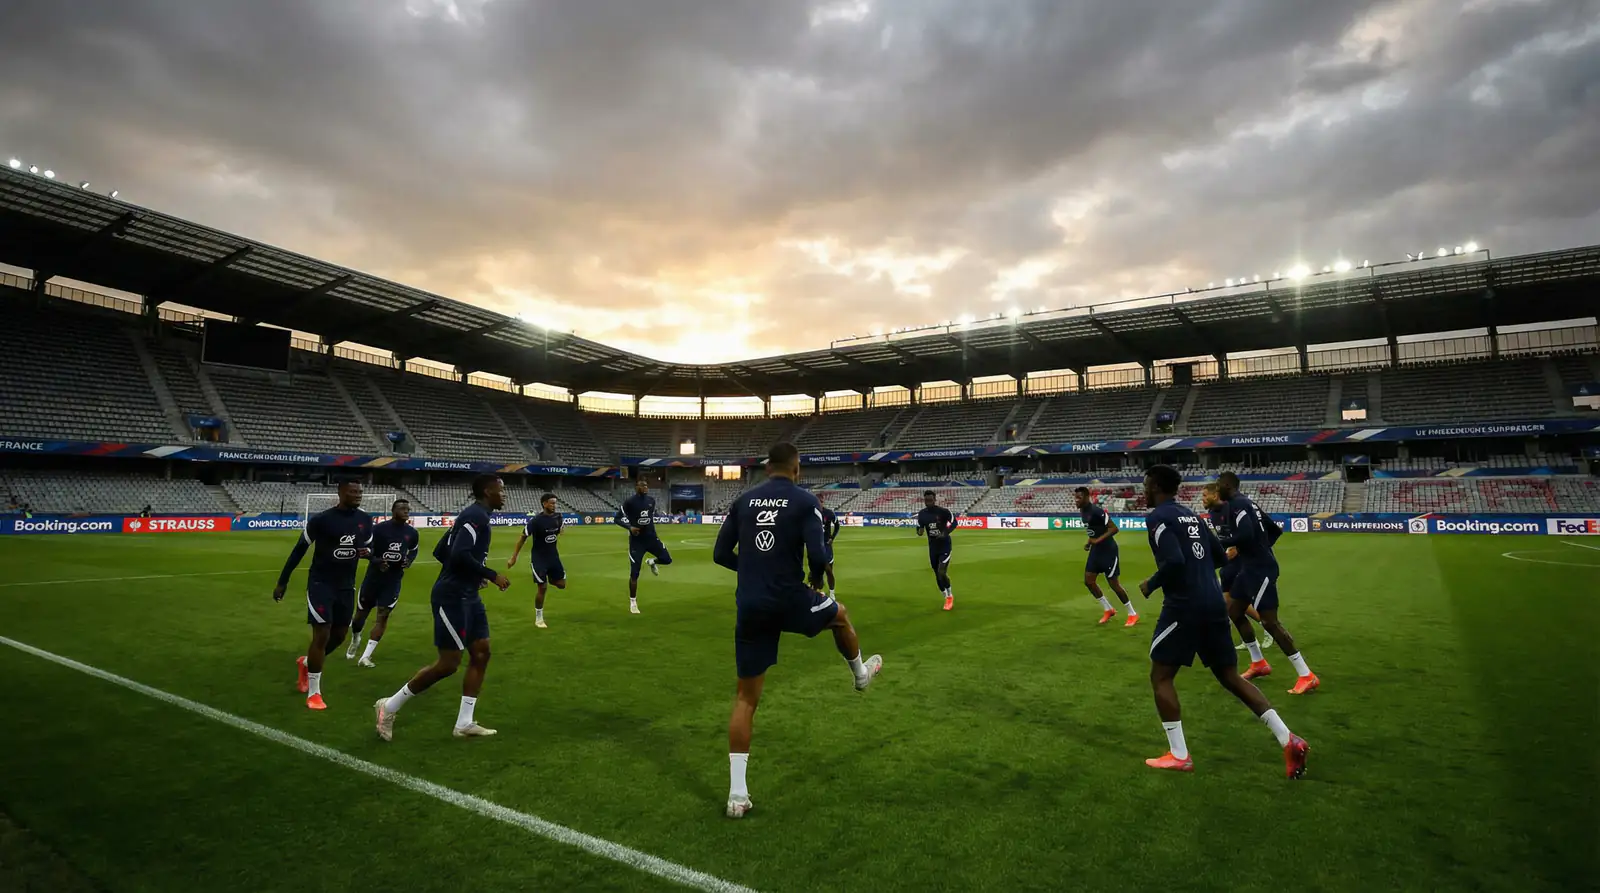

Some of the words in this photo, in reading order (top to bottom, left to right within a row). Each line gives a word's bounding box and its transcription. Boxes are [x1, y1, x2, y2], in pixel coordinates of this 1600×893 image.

[0, 441, 43, 450] FRANCE
[749, 499, 788, 507] FRANCE
[15, 520, 112, 533] Booking.com
[149, 519, 215, 530] STRAUSS
[1001, 518, 1031, 528] FedEx
[1436, 520, 1539, 533] Booking.com
[1557, 520, 1600, 533] FedE
